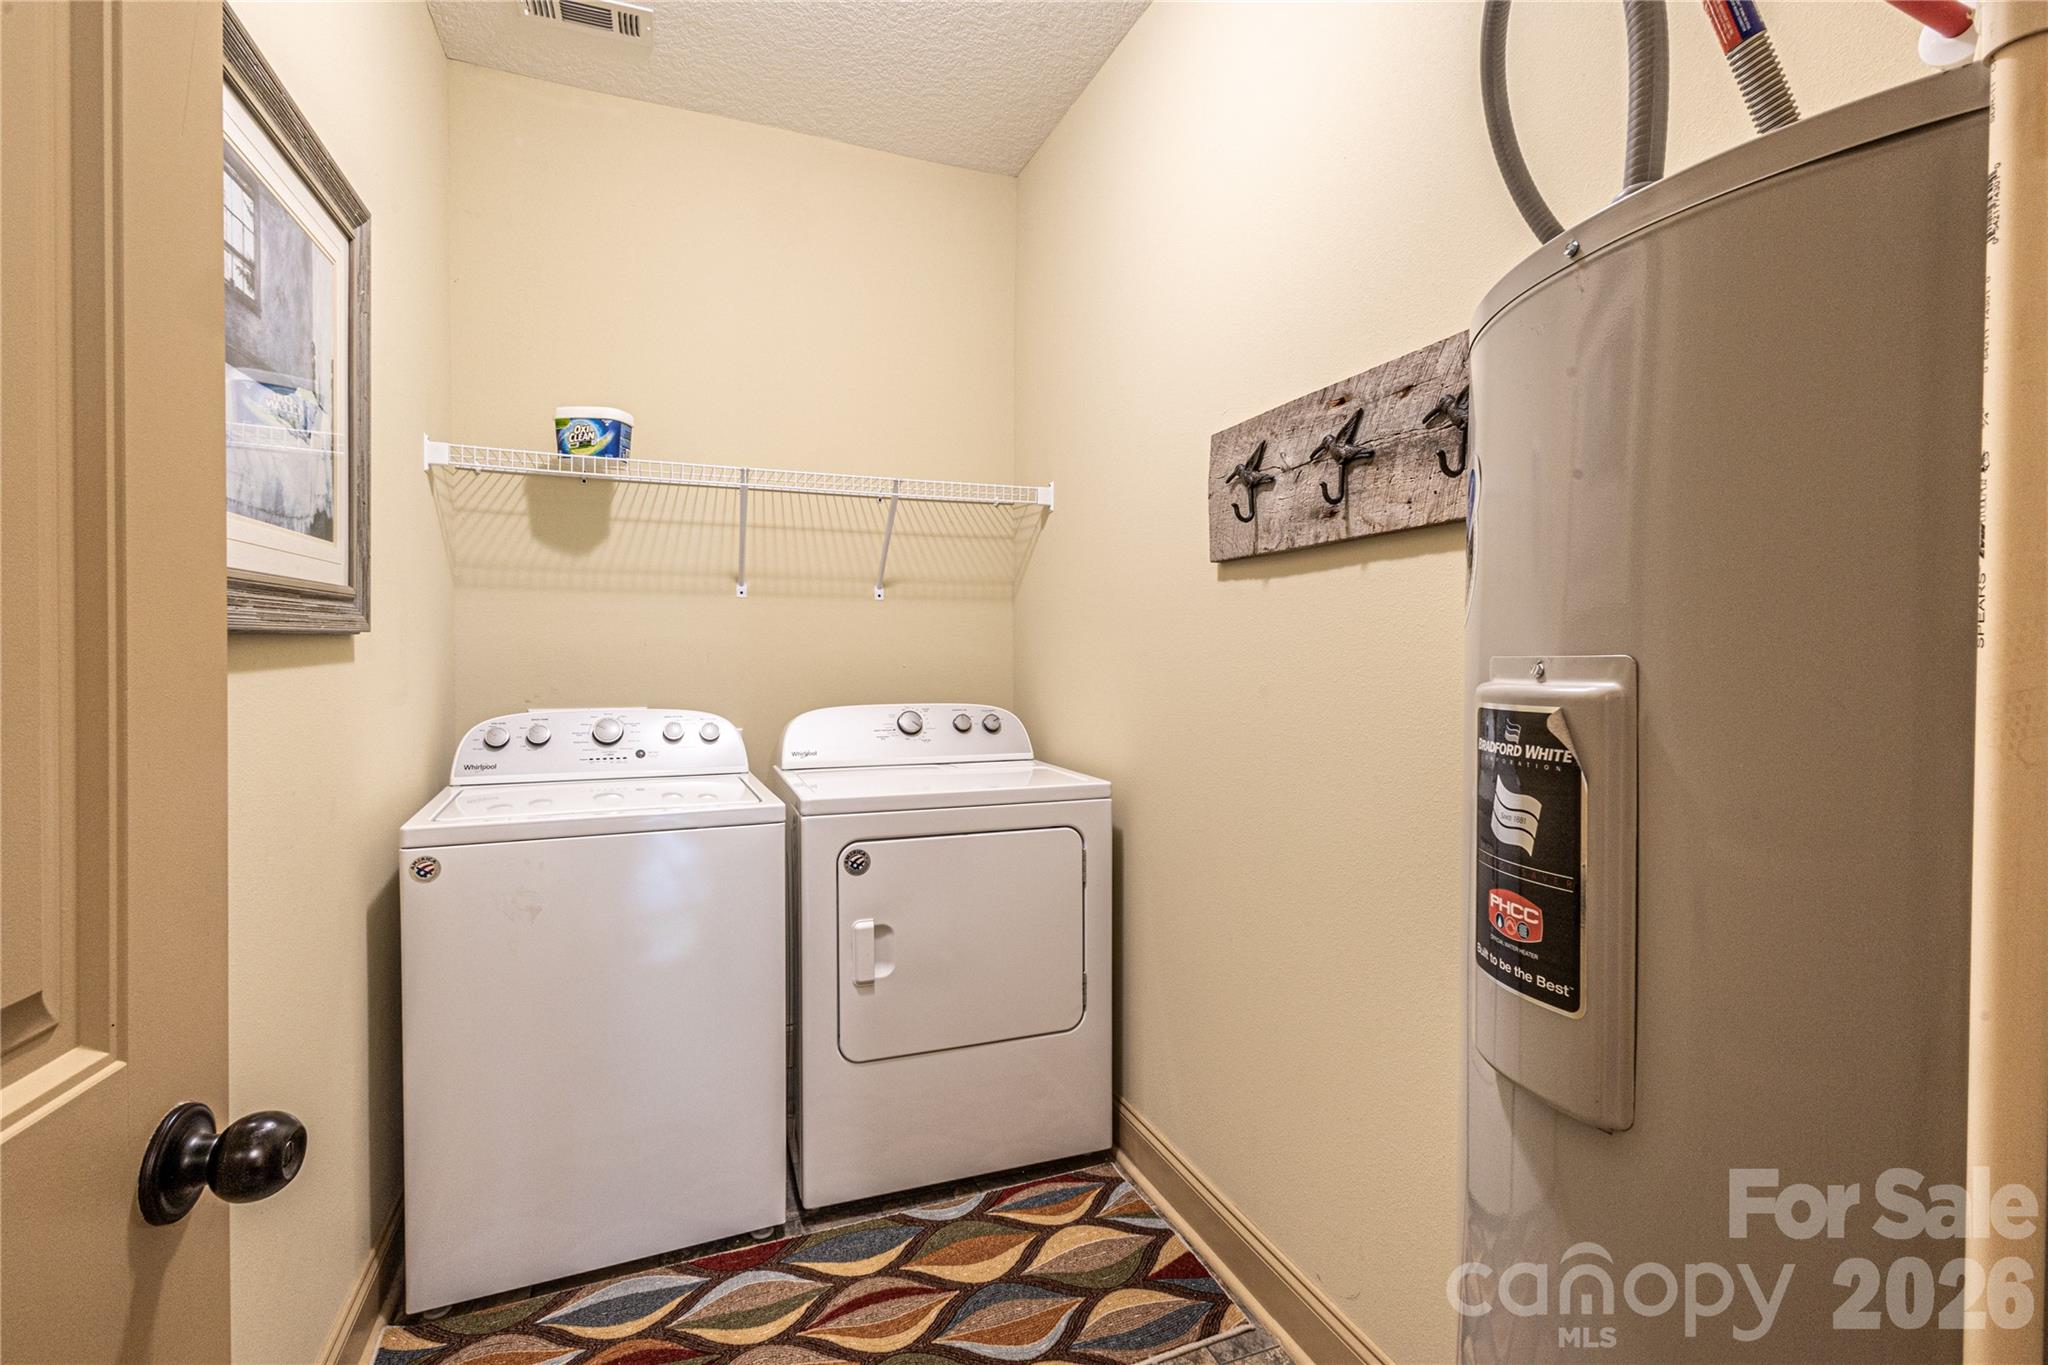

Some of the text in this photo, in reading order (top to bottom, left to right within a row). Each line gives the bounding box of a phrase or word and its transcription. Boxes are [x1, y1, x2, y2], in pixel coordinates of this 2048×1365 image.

[574, 425, 590, 434] OXI
[568, 431, 595, 443] CLEAN
[1976, 573, 1987, 649] SPEARS
[791, 750, 818, 759] Whirlpool
[1478, 737, 1573, 763] BRADFORD WHITE
[463, 763, 497, 771] Whirlpool
[1489, 893, 1540, 925] PHCC
[1519, 948, 1539, 960] HEATER
[1476, 941, 1489, 960] Built
[1489, 952, 1498, 966] to
[1499, 958, 1512, 973] be
[1513, 965, 1533, 983] the
